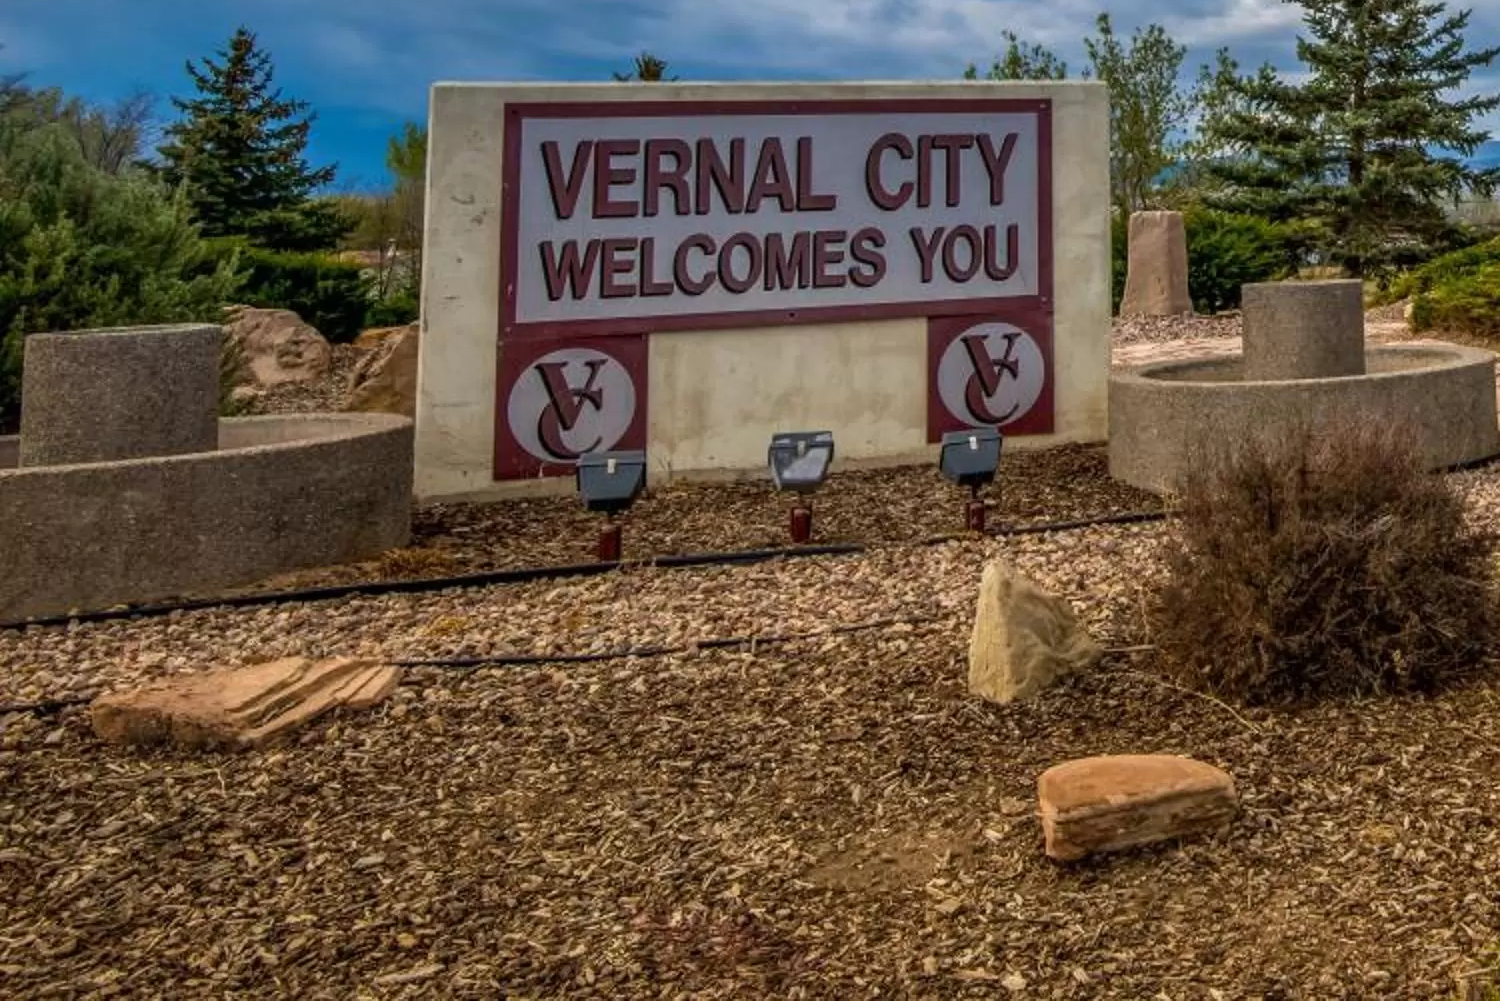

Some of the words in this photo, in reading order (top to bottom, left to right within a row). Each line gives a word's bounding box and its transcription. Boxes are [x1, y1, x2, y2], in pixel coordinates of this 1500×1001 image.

[541, 136, 837, 219] VERNAL
[866, 132, 1019, 211] CITY
[540, 227, 887, 301] WELCOMES
[910, 224, 1019, 283] YOU
